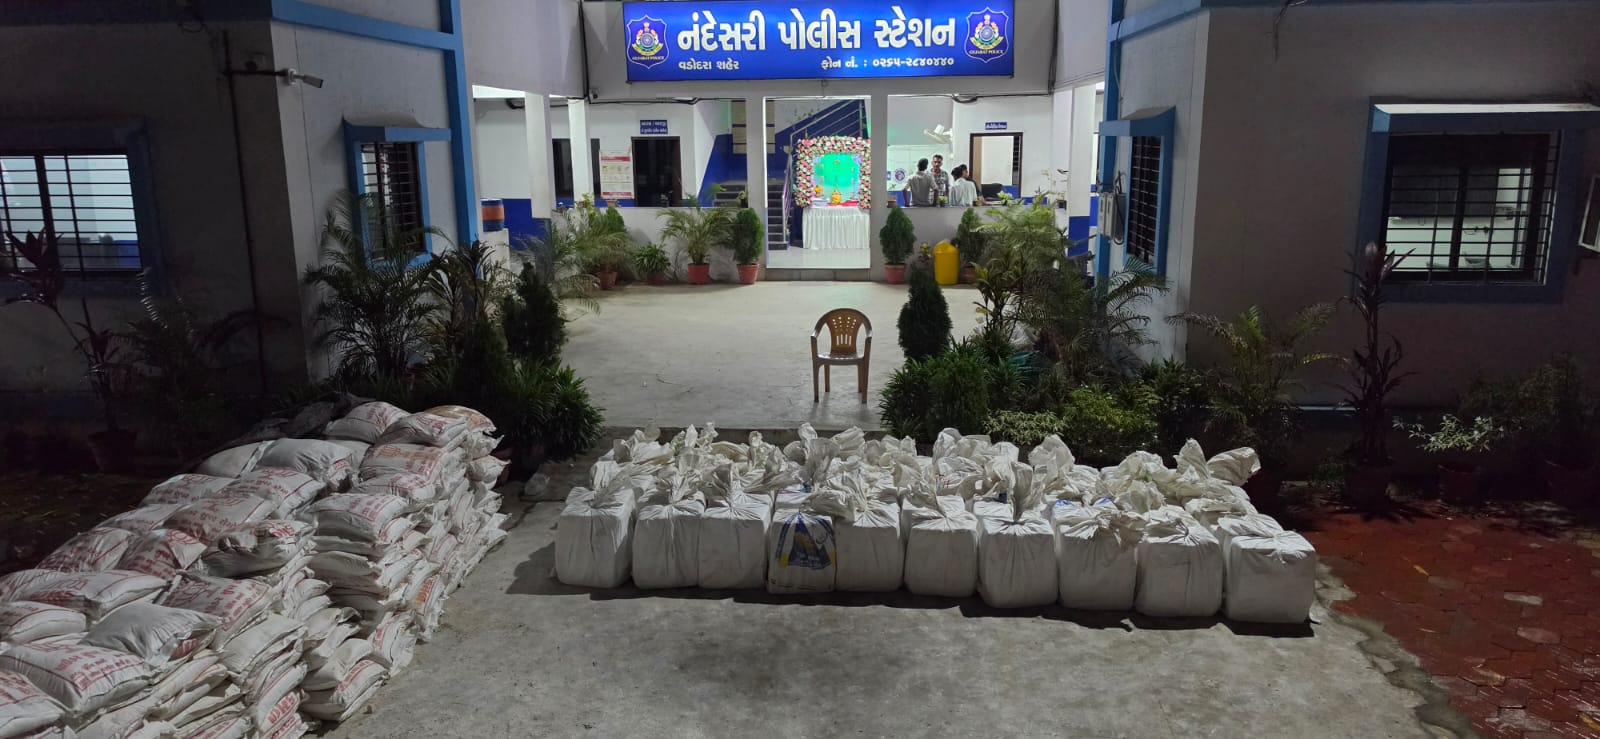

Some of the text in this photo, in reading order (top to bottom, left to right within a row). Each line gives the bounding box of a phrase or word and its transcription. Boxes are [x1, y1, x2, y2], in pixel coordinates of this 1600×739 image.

[677, 6, 955, 51] નંદેસરી પોલીસ સ્ટેશન
[678, 58, 739, 70] વડોદરા શહેર
[820, 56, 842, 70] ફોન
